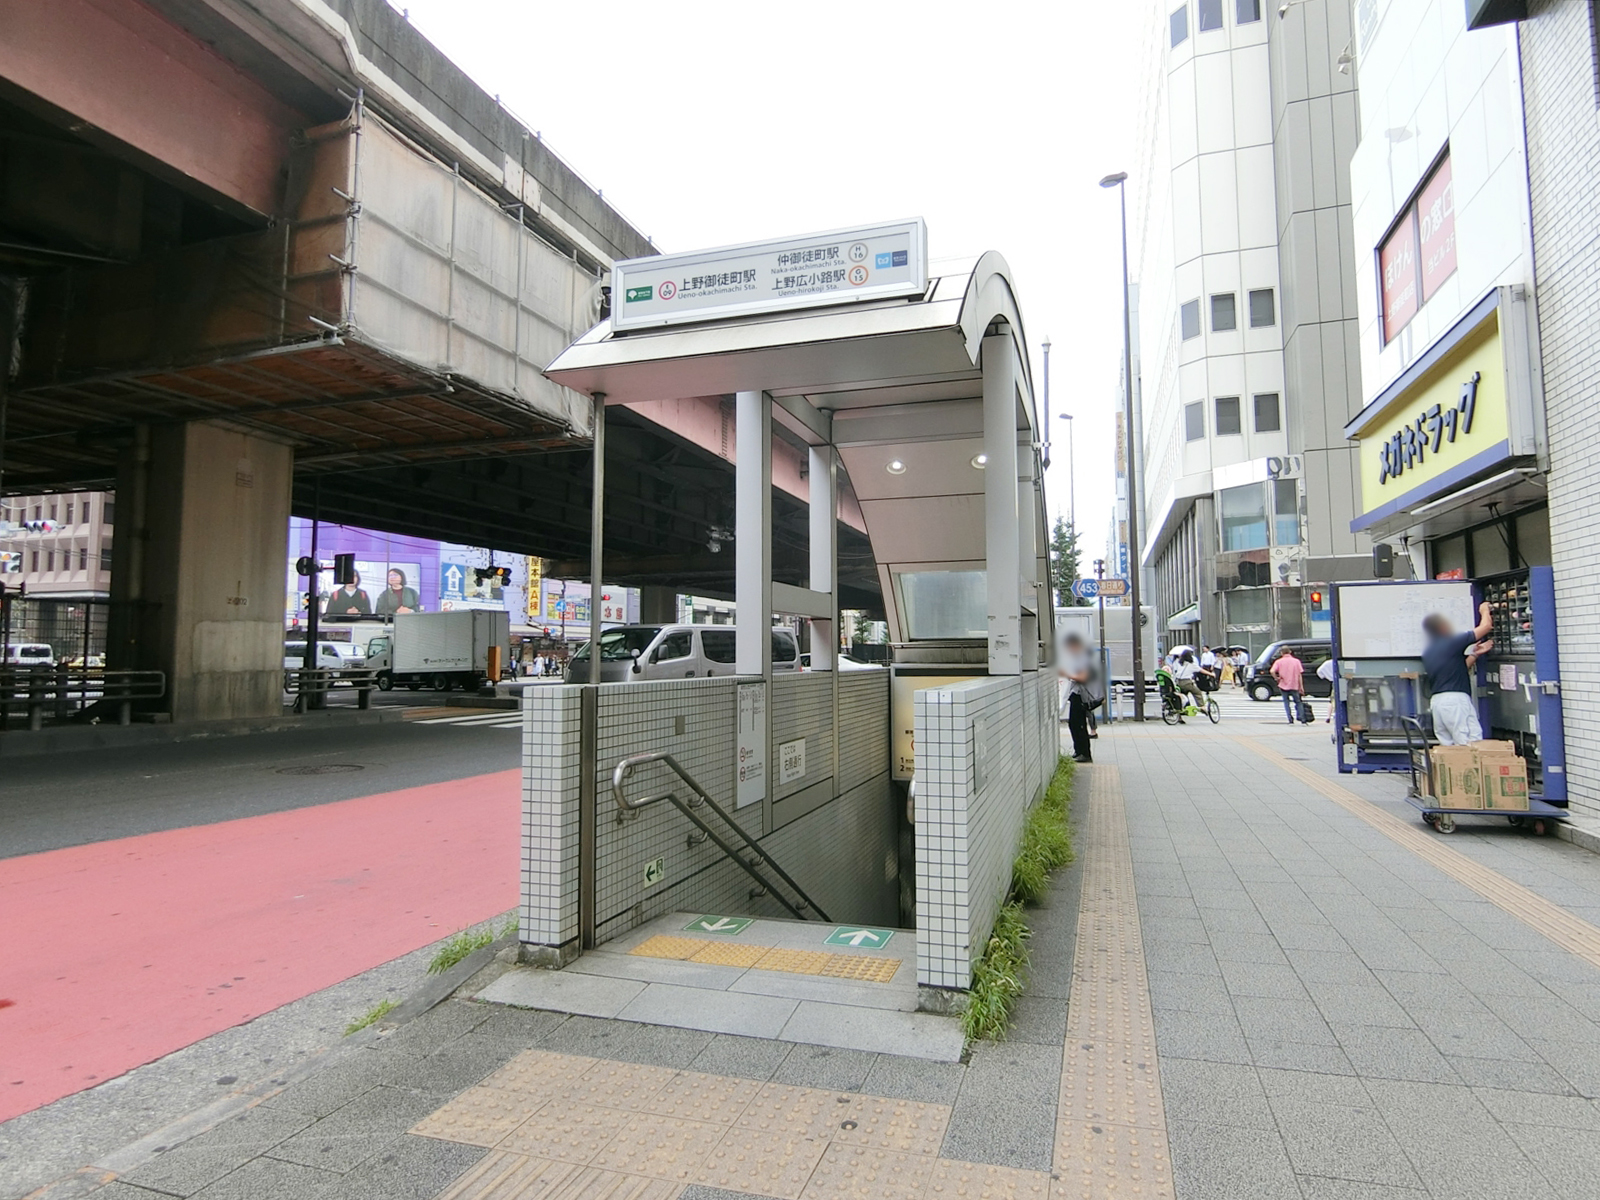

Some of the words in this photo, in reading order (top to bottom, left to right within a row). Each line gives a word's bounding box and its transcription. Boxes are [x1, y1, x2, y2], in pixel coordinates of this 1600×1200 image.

[777, 246, 840, 267] 仲御徒町駅
[854, 252, 863, 260] 16
[770, 262, 832, 275] Naka-okachimachi
[833, 259, 847, 267] Sta.
[678, 268, 757, 292] 上野御徒町駅
[771, 268, 847, 291] 上野広小路駅
[662, 289, 672, 297] 09
[677, 284, 743, 300] Ueno-okachimachi
[743, 283, 758, 291] Sta.
[777, 285, 825, 297] Ueno-hirokoji
[826, 283, 840, 291] Sta.
[1378, 371, 1481, 485] メガネドラッグ
[1080, 582, 1098, 594] 453
